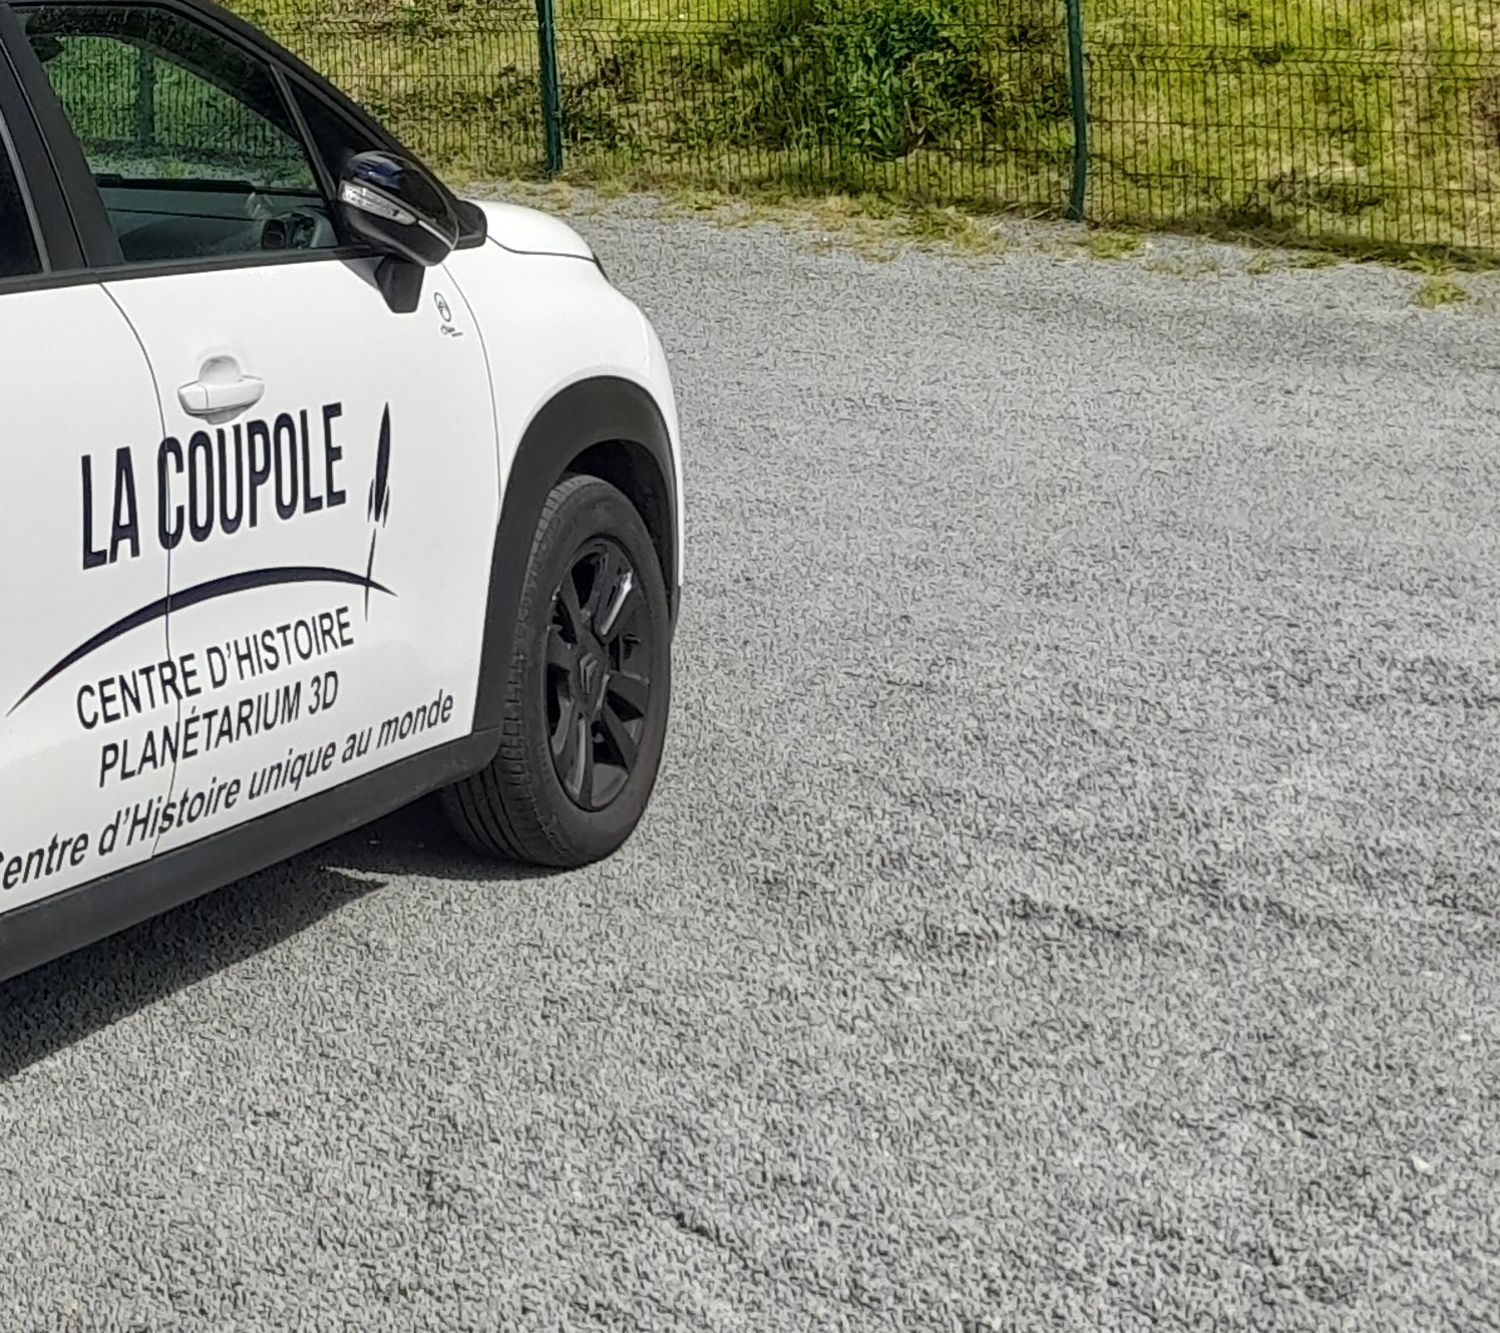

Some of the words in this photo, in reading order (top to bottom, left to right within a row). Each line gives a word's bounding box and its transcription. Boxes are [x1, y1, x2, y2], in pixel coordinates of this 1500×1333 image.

[80, 446, 140, 570] LA
[157, 401, 347, 550] COUPOLE
[76, 652, 202, 730] CENTRE
[206, 606, 355, 690] D'HISTOIRE
[99, 683, 301, 788] PLANÉTARIUM
[307, 670, 340, 717] 3D
[98, 774, 238, 860] d'Histoire
[248, 735, 334, 802] unique
[341, 724, 370, 760] au
[376, 688, 455, 750] monde
